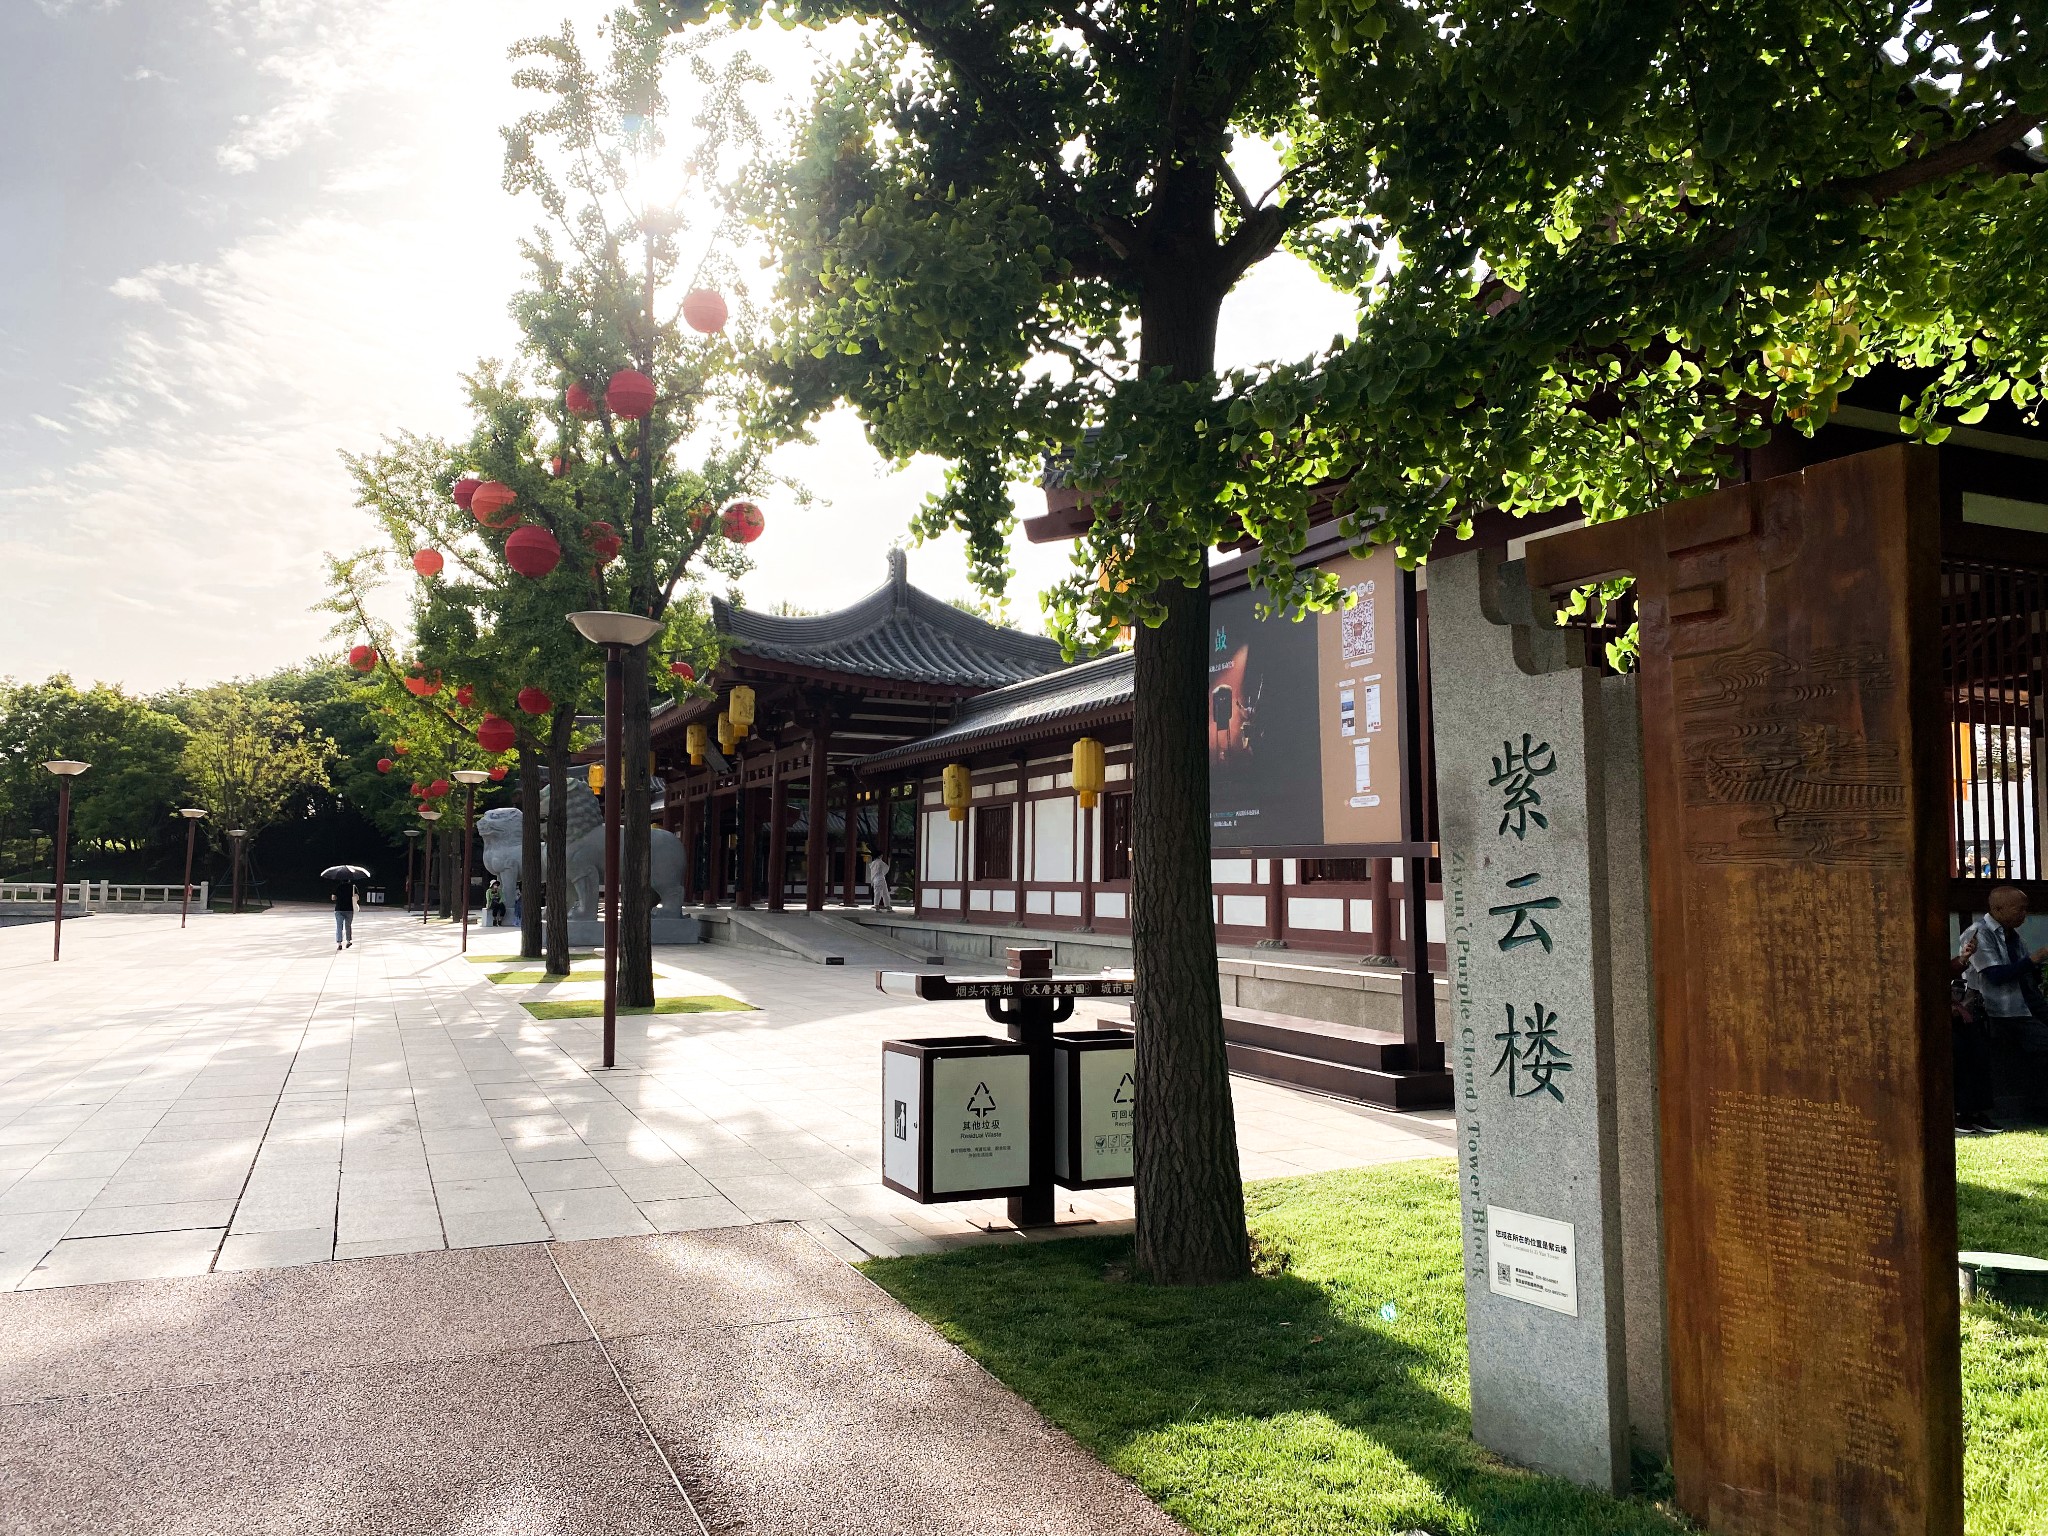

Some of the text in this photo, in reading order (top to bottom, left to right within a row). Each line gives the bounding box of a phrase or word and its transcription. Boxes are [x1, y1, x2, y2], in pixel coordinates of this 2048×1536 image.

[1488, 732, 1573, 1104] 紫云楼
[956, 984, 1014, 997] 烟头不落地
[1451, 851, 1486, 1280] Ziyun (Purple Cloud) Tower Block
[1832, 1102, 1861, 1114] Block
[963, 1119, 1001, 1131] 其他垃圾
